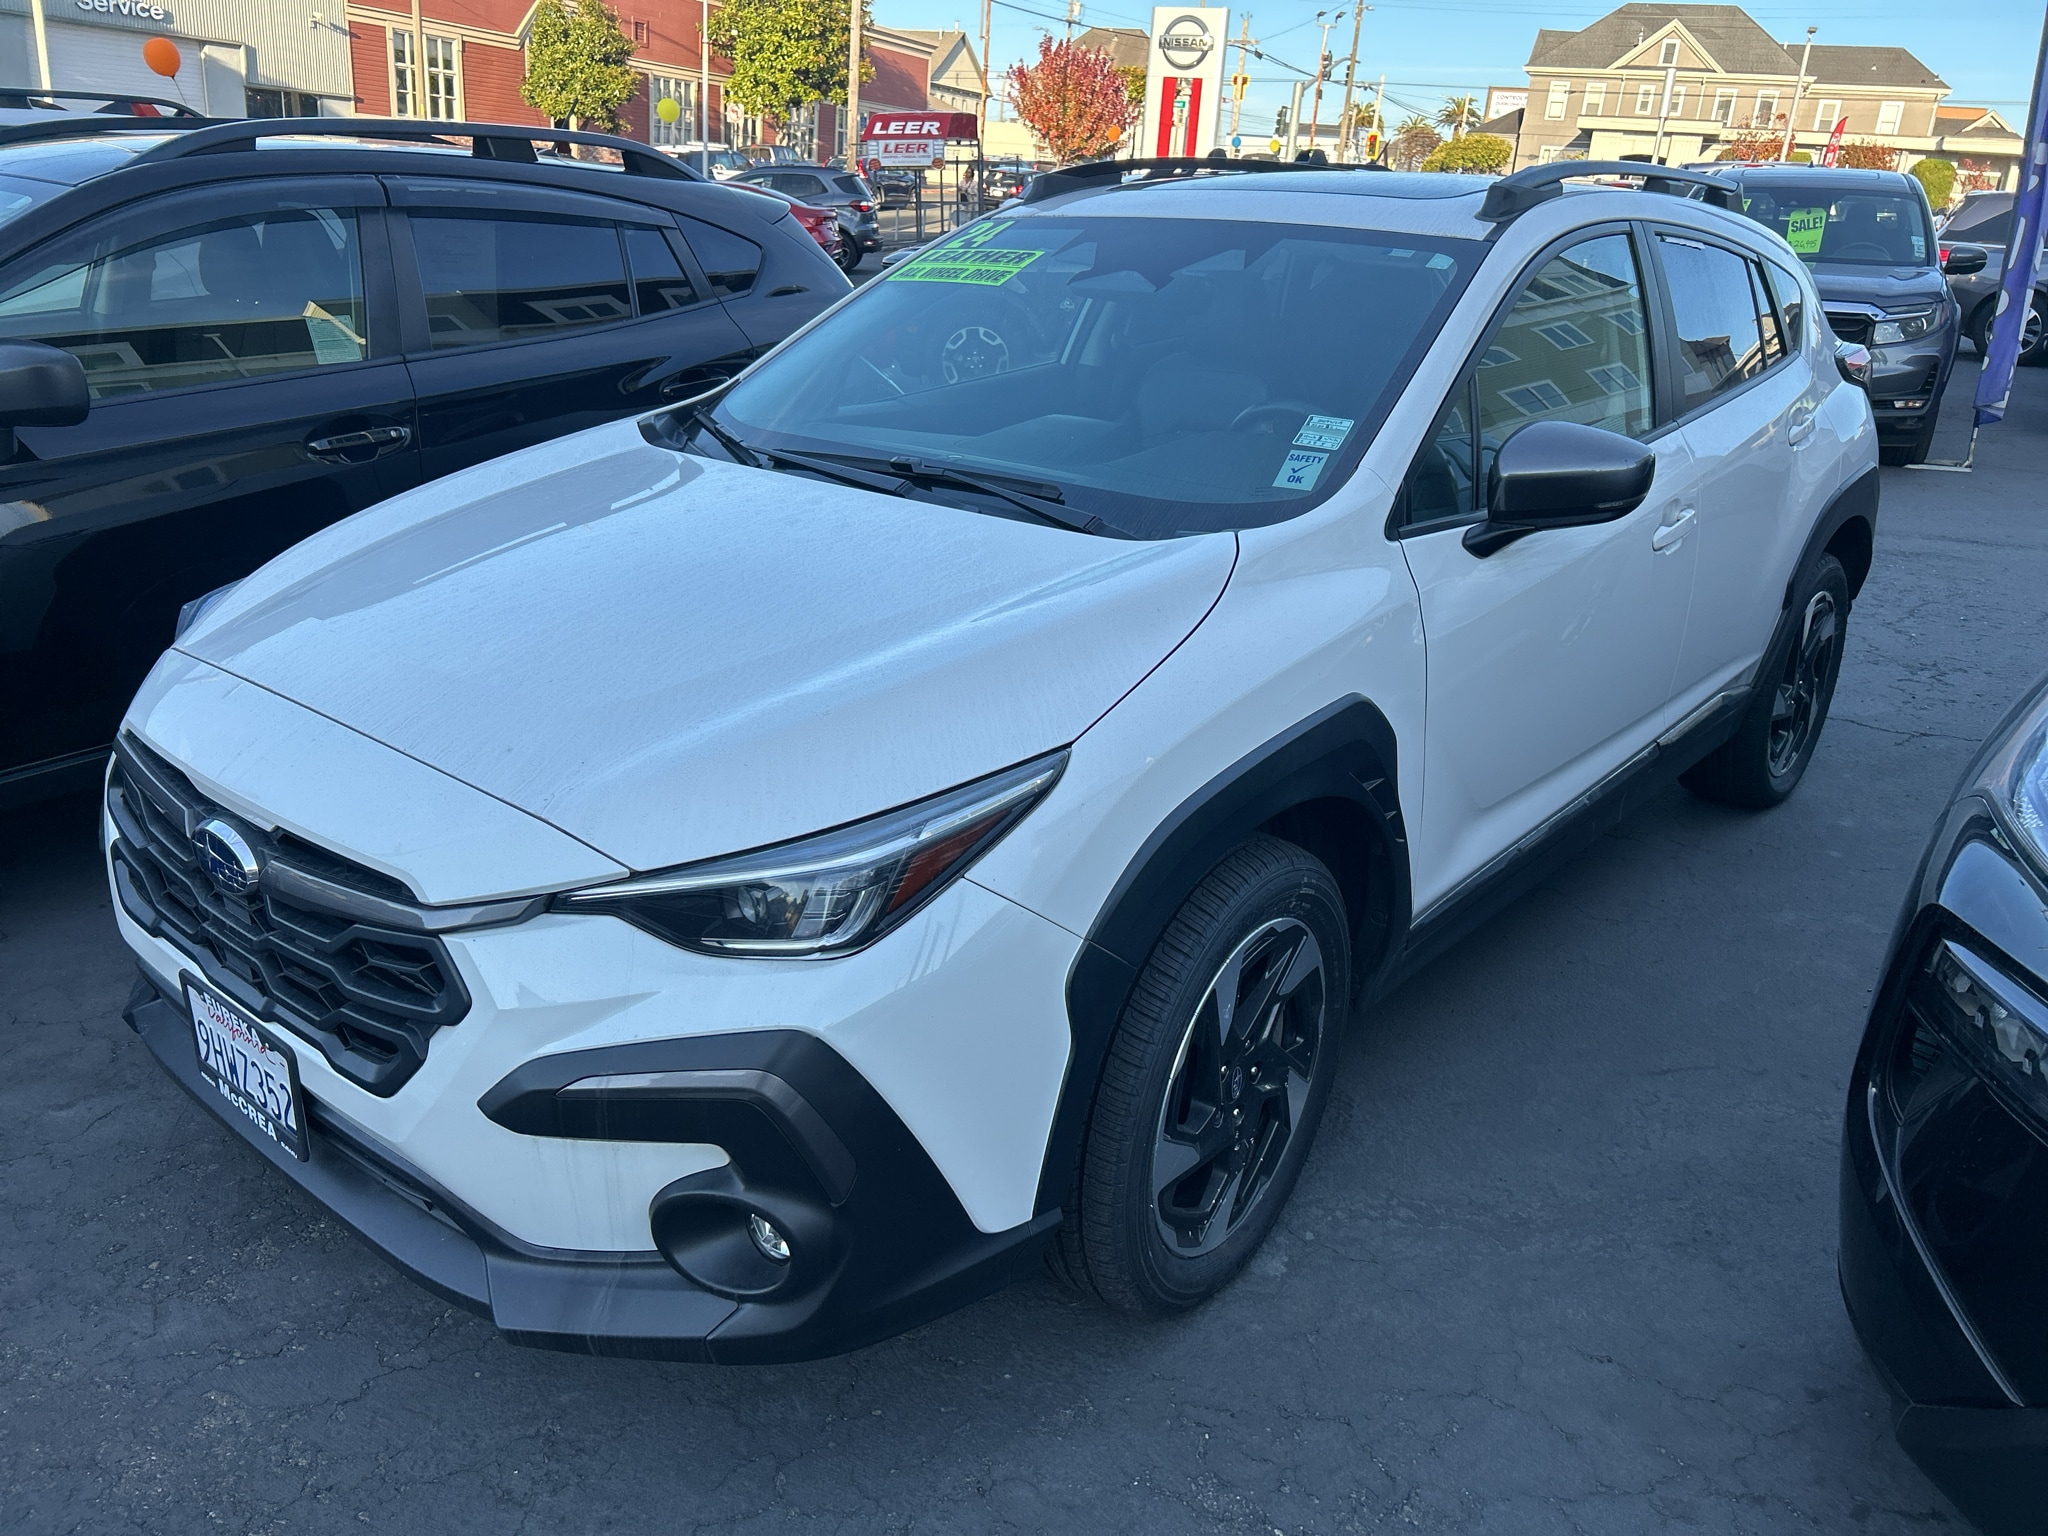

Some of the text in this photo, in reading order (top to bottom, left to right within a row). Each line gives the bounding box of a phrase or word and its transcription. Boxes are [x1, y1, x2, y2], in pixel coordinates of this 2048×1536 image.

[77, 0, 165, 20] Service
[1163, 37, 1208, 47] NISSAN
[872, 121, 940, 136] LEER
[883, 142, 928, 154] LEER
[1790, 216, 1823, 233] SALE!
[943, 221, 1016, 248] 24
[918, 251, 1036, 267] LEATHER
[894, 267, 1014, 282] ALL WHEEL DRIVE
[1288, 453, 1323, 464] SAFETY
[1287, 475, 1304, 484] OK
[203, 992, 264, 1046] EUREKA
[198, 1019, 297, 1134] 9HWZ352
[218, 1078, 278, 1142] McCREA
